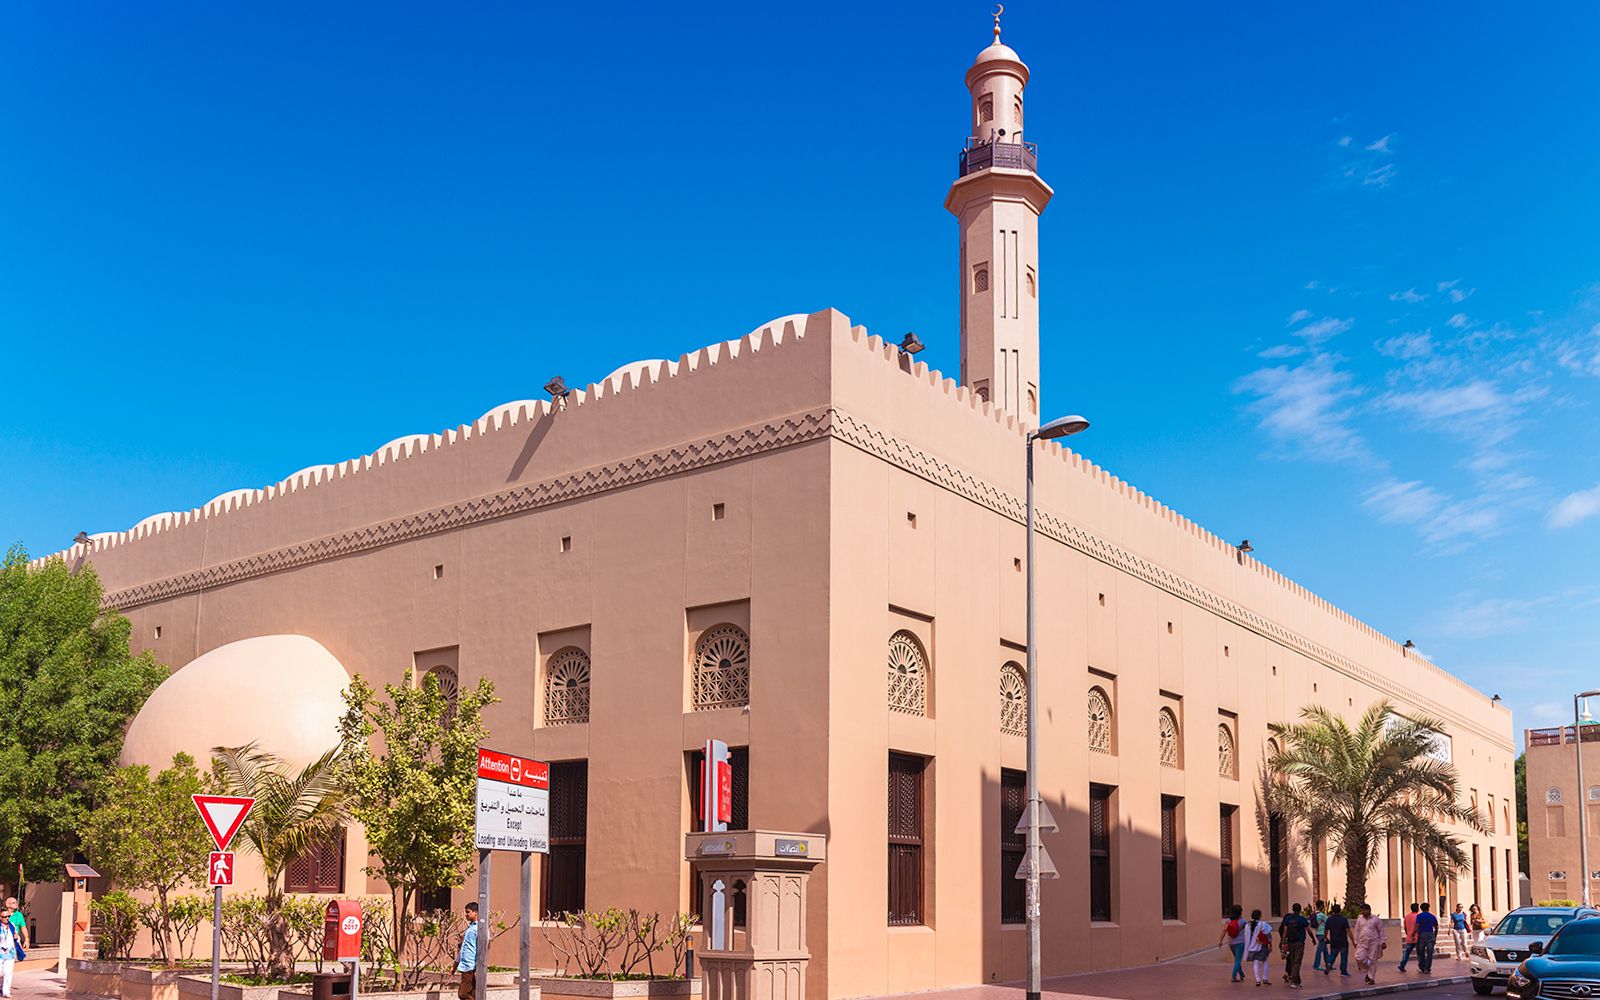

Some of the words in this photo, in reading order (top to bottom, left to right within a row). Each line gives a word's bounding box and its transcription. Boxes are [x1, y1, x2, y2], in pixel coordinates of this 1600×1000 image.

[480, 756, 510, 773] Attention
[507, 818, 522, 832] Except
[478, 833, 496, 847] Loading
[497, 835, 506, 846] and
[507, 836, 528, 850] Unloading
[529, 838, 547, 849] Vehicles
